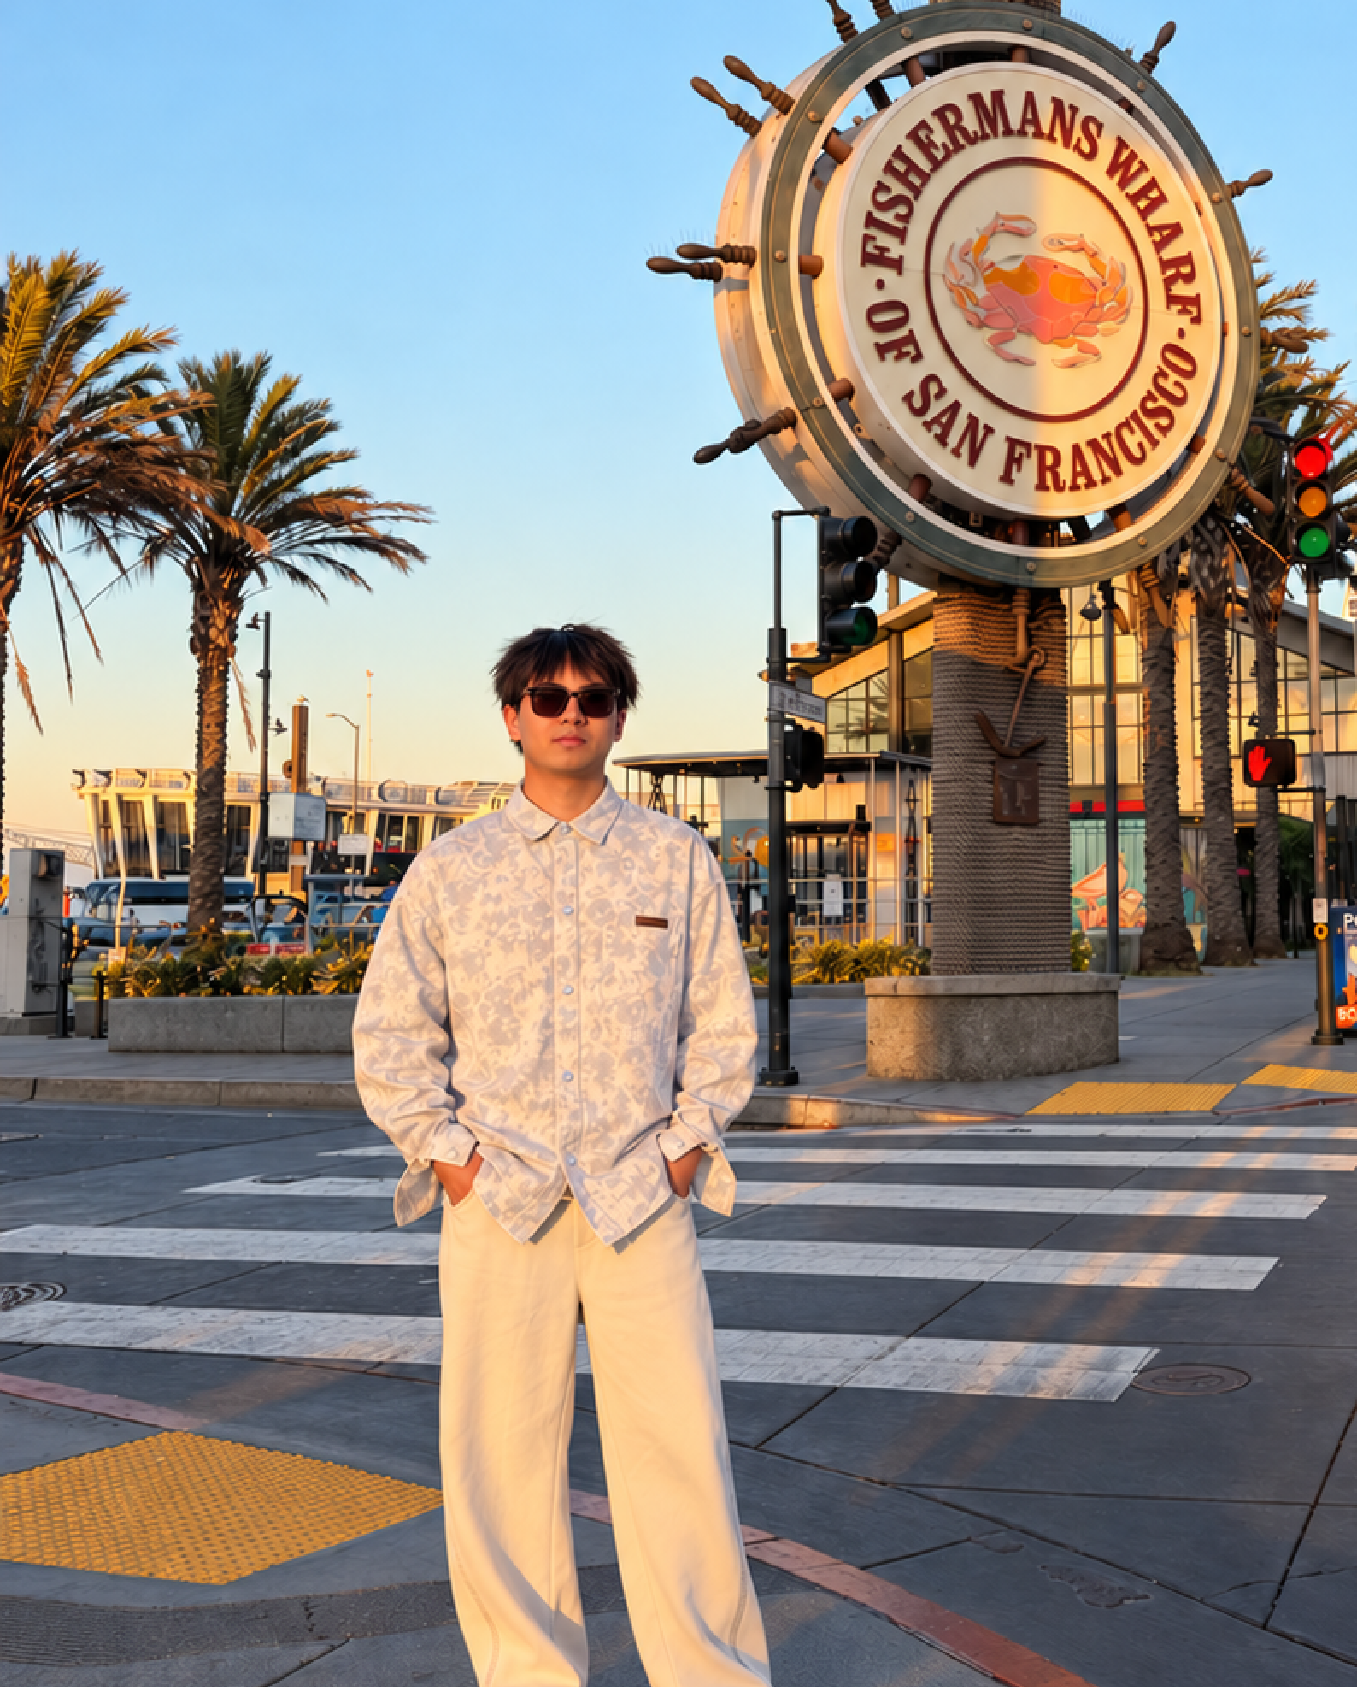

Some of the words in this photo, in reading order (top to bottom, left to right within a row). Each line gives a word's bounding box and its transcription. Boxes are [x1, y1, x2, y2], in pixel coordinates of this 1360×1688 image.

[860, 89, 1104, 275] FISHERMANS
[1106, 135, 1202, 325] WHARF
[865, 300, 923, 364] OF
[902, 373, 996, 468] SAN
[999, 343, 1197, 492] FRANCISCO
